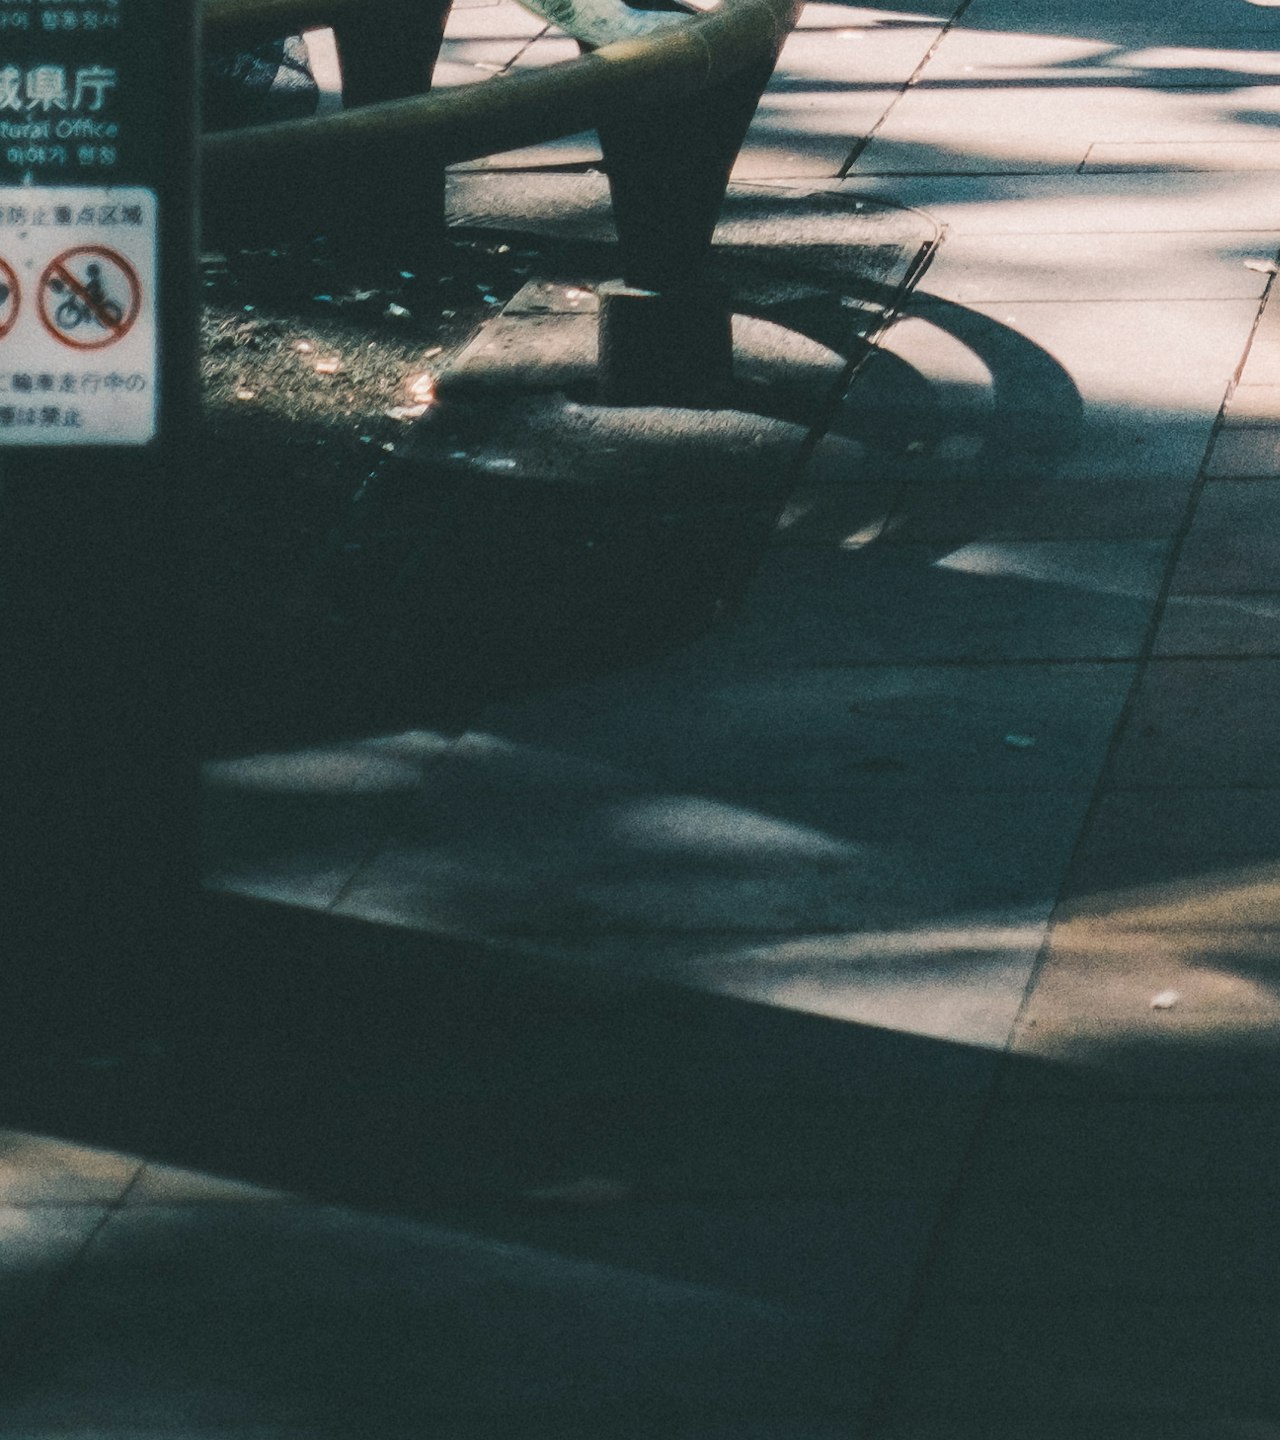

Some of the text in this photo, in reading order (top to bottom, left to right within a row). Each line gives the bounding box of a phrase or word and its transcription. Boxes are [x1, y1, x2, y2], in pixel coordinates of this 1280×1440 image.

[55, 117, 119, 140] Office
[0, 205, 143, 227] 防止重点区域
